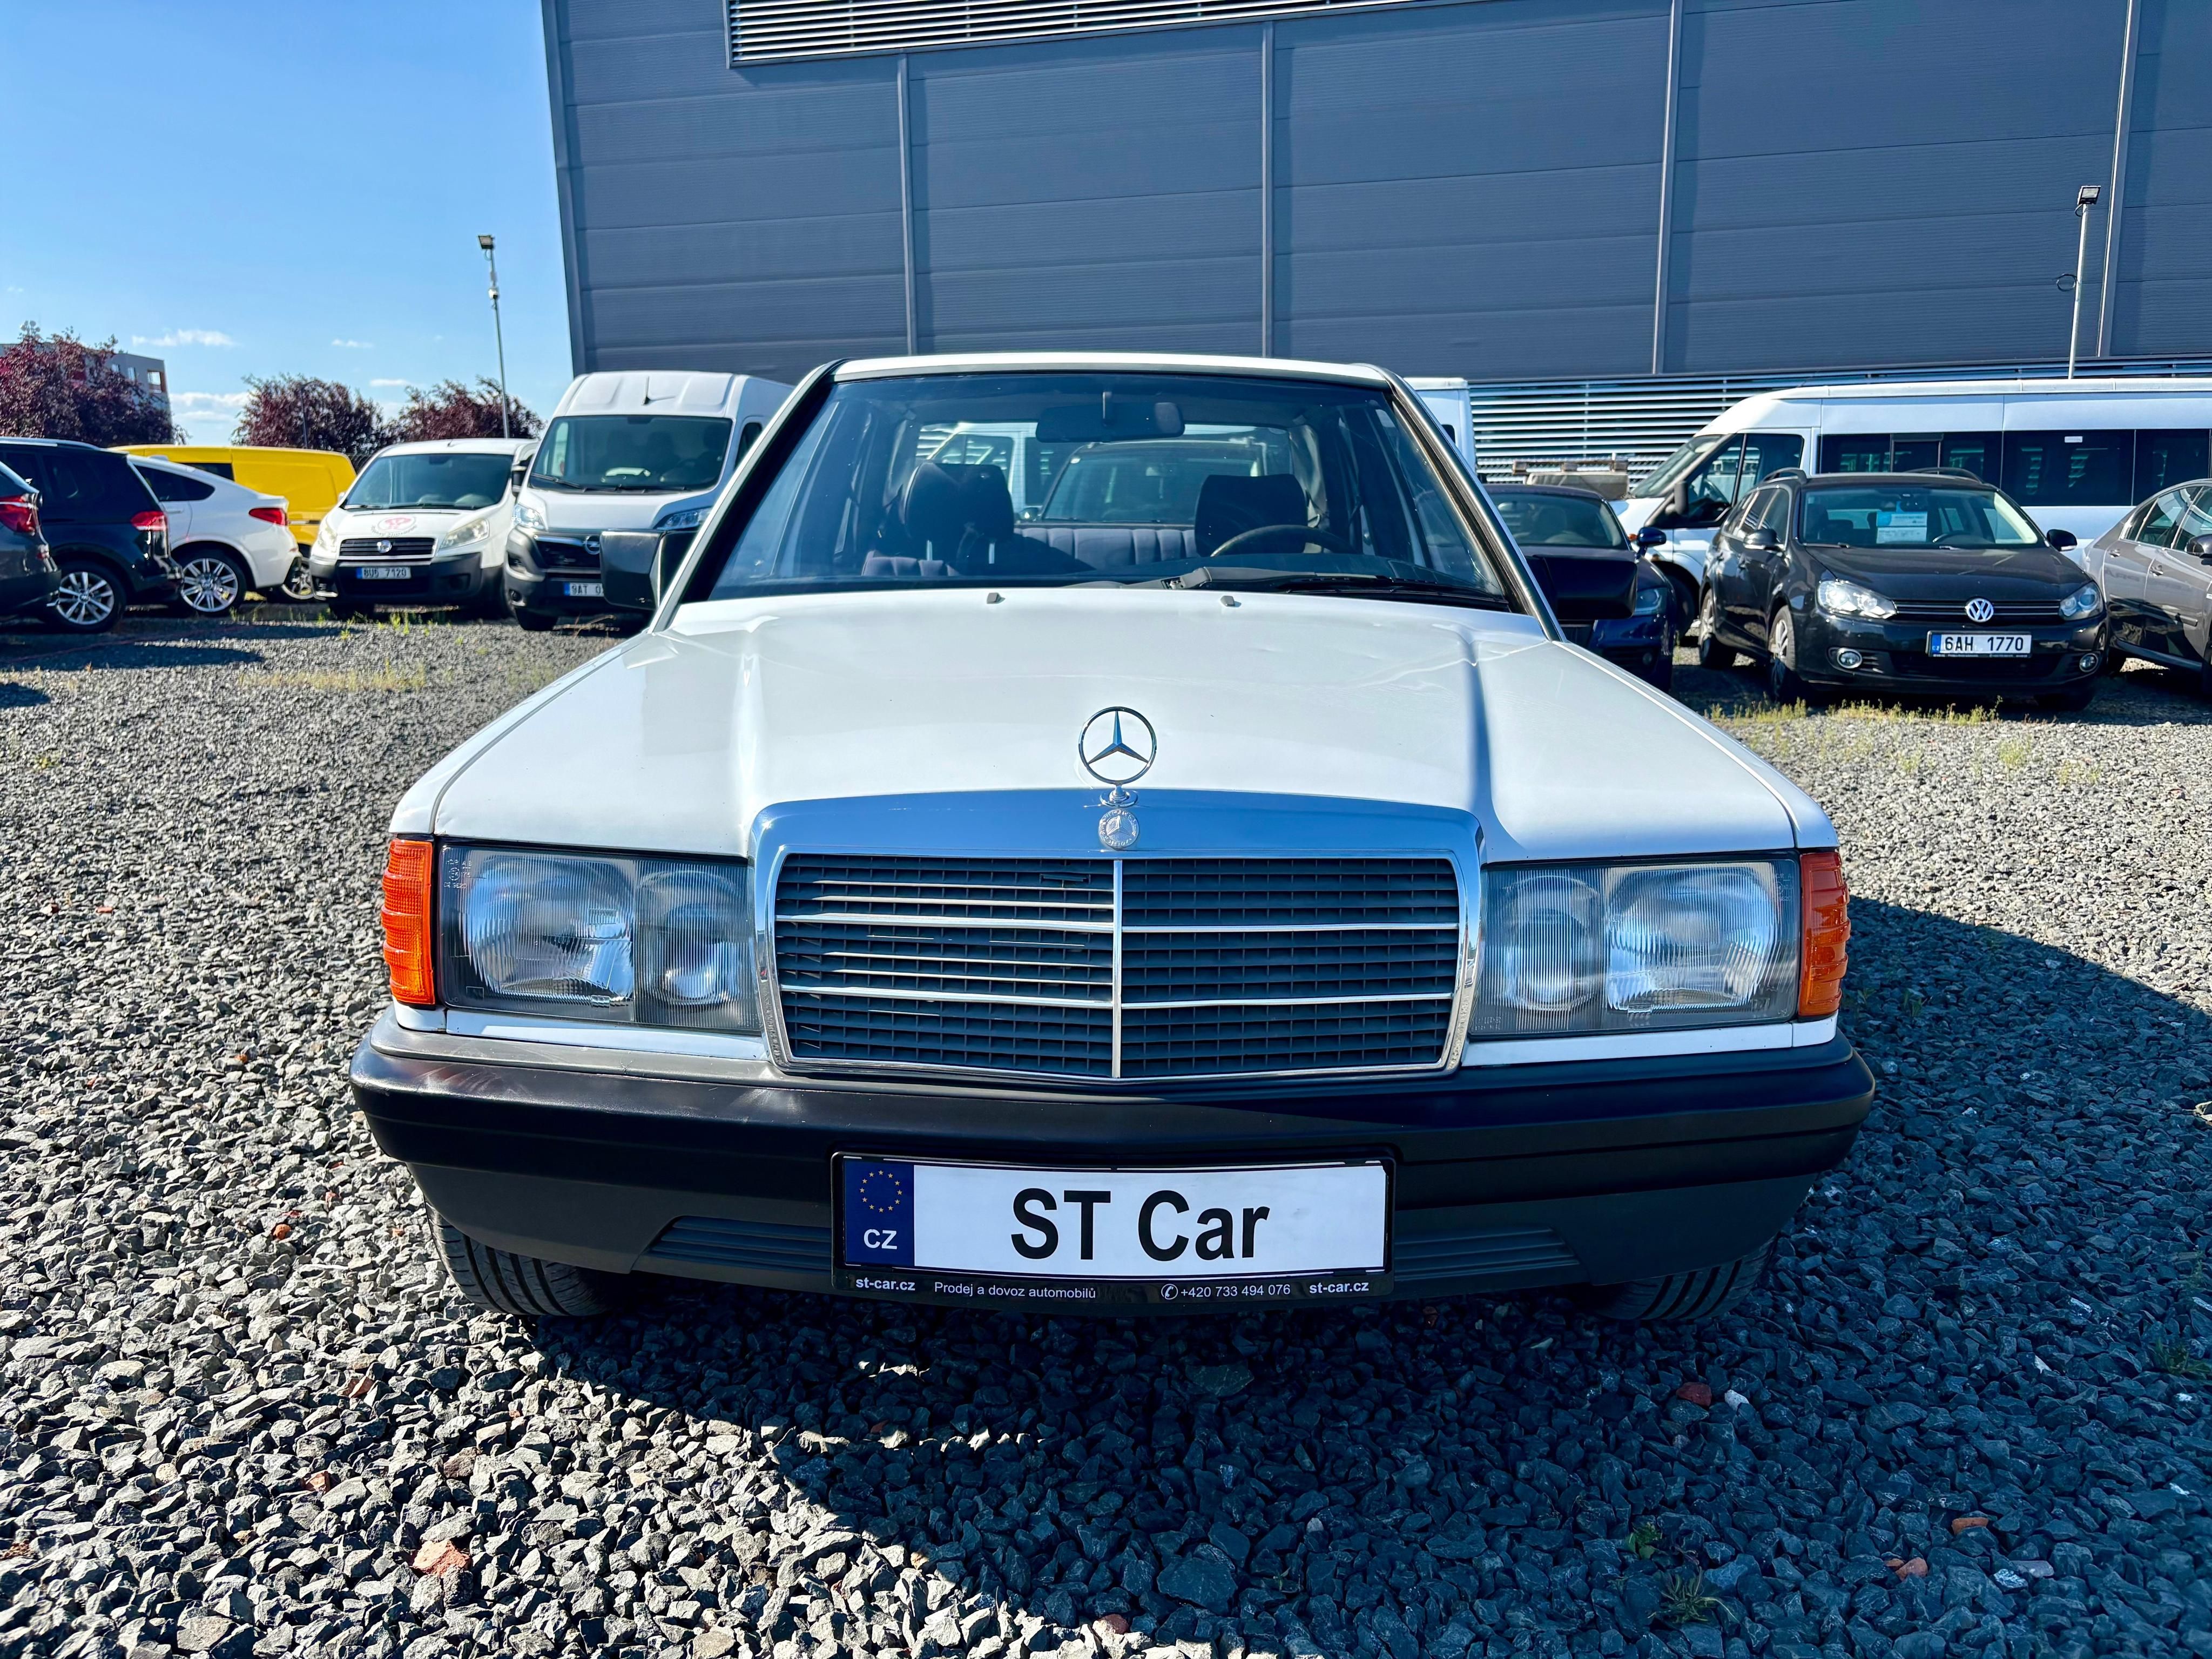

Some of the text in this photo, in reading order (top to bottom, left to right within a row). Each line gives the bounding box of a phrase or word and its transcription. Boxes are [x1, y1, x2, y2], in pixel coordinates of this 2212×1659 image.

[1945, 637, 2024, 651] 6AH 1770
[1010, 1187, 1270, 1262] ST Car
[862, 1229, 898, 1251] CZ
[855, 1278, 916, 1292] st-car.cz
[934, 1282, 1096, 1299] Prodej a dovoz automobilů
[1181, 1284, 1291, 1298] +420 733 494 076
[1309, 1282, 1370, 1294] st-car.cz
